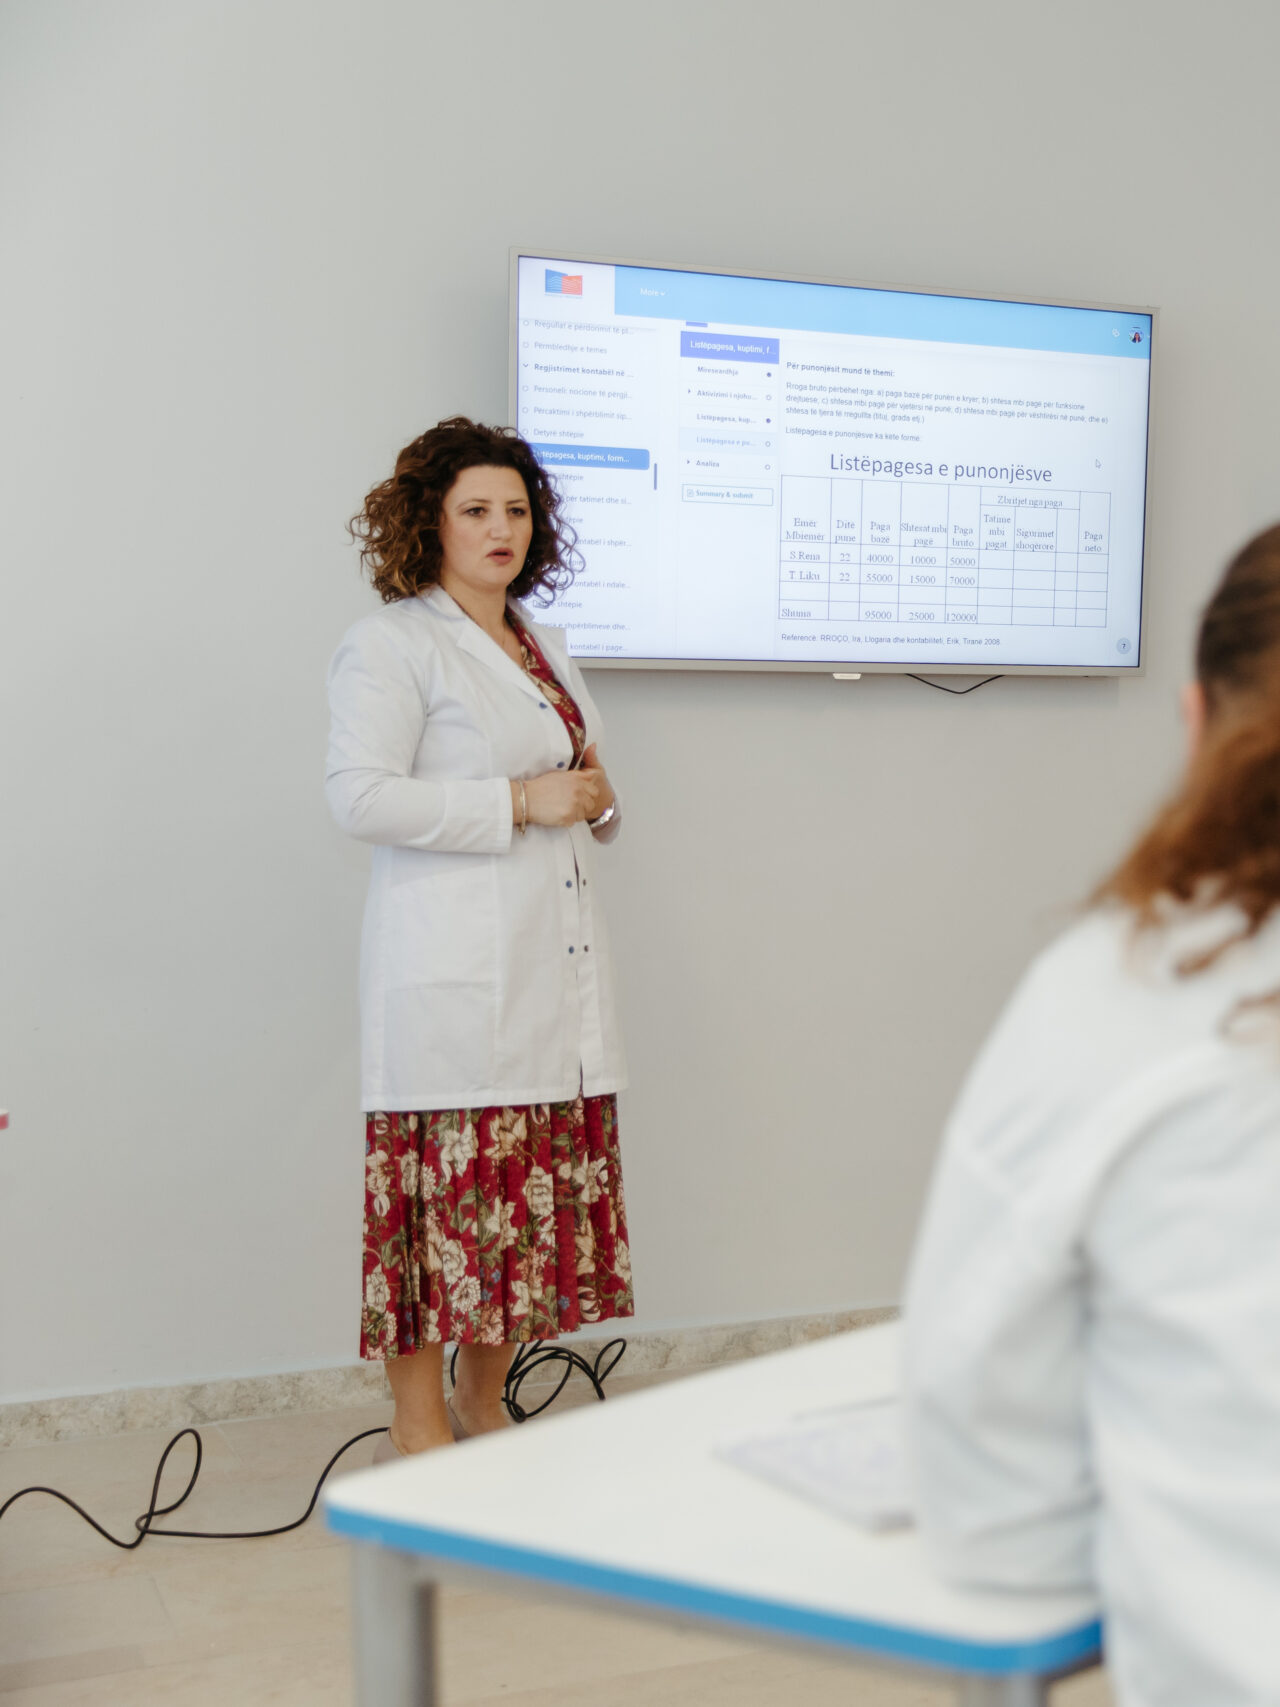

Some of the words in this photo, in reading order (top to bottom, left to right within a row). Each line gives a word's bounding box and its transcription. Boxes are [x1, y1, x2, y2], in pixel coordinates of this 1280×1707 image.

[830, 453, 934, 478] Listëpagesa
[938, 463, 948, 476] e
[954, 463, 1052, 484] punonjësve
[983, 514, 1011, 524] Tatime
[870, 522, 891, 532] Paga
[900, 522, 931, 533] Shtesat
[953, 525, 974, 535] Paga
[989, 528, 1005, 536] mbi
[1016, 528, 1054, 539] Sigurimet
[1084, 530, 1103, 540] Paga
[951, 537, 974, 547] bruto
[985, 541, 1007, 550] pagat
[840, 553, 850, 562] 22
[866, 554, 894, 563] 40000
[911, 556, 936, 565] 10000
[950, 557, 976, 566] 50000
[839, 572, 850, 581] 22
[866, 573, 893, 582] 55000
[910, 575, 936, 584] 15000
[950, 576, 975, 585] 70000
[781, 608, 811, 617] Shuma
[865, 611, 892, 620] 95000
[908, 612, 935, 621] 25000
[947, 613, 977, 622] 120000
